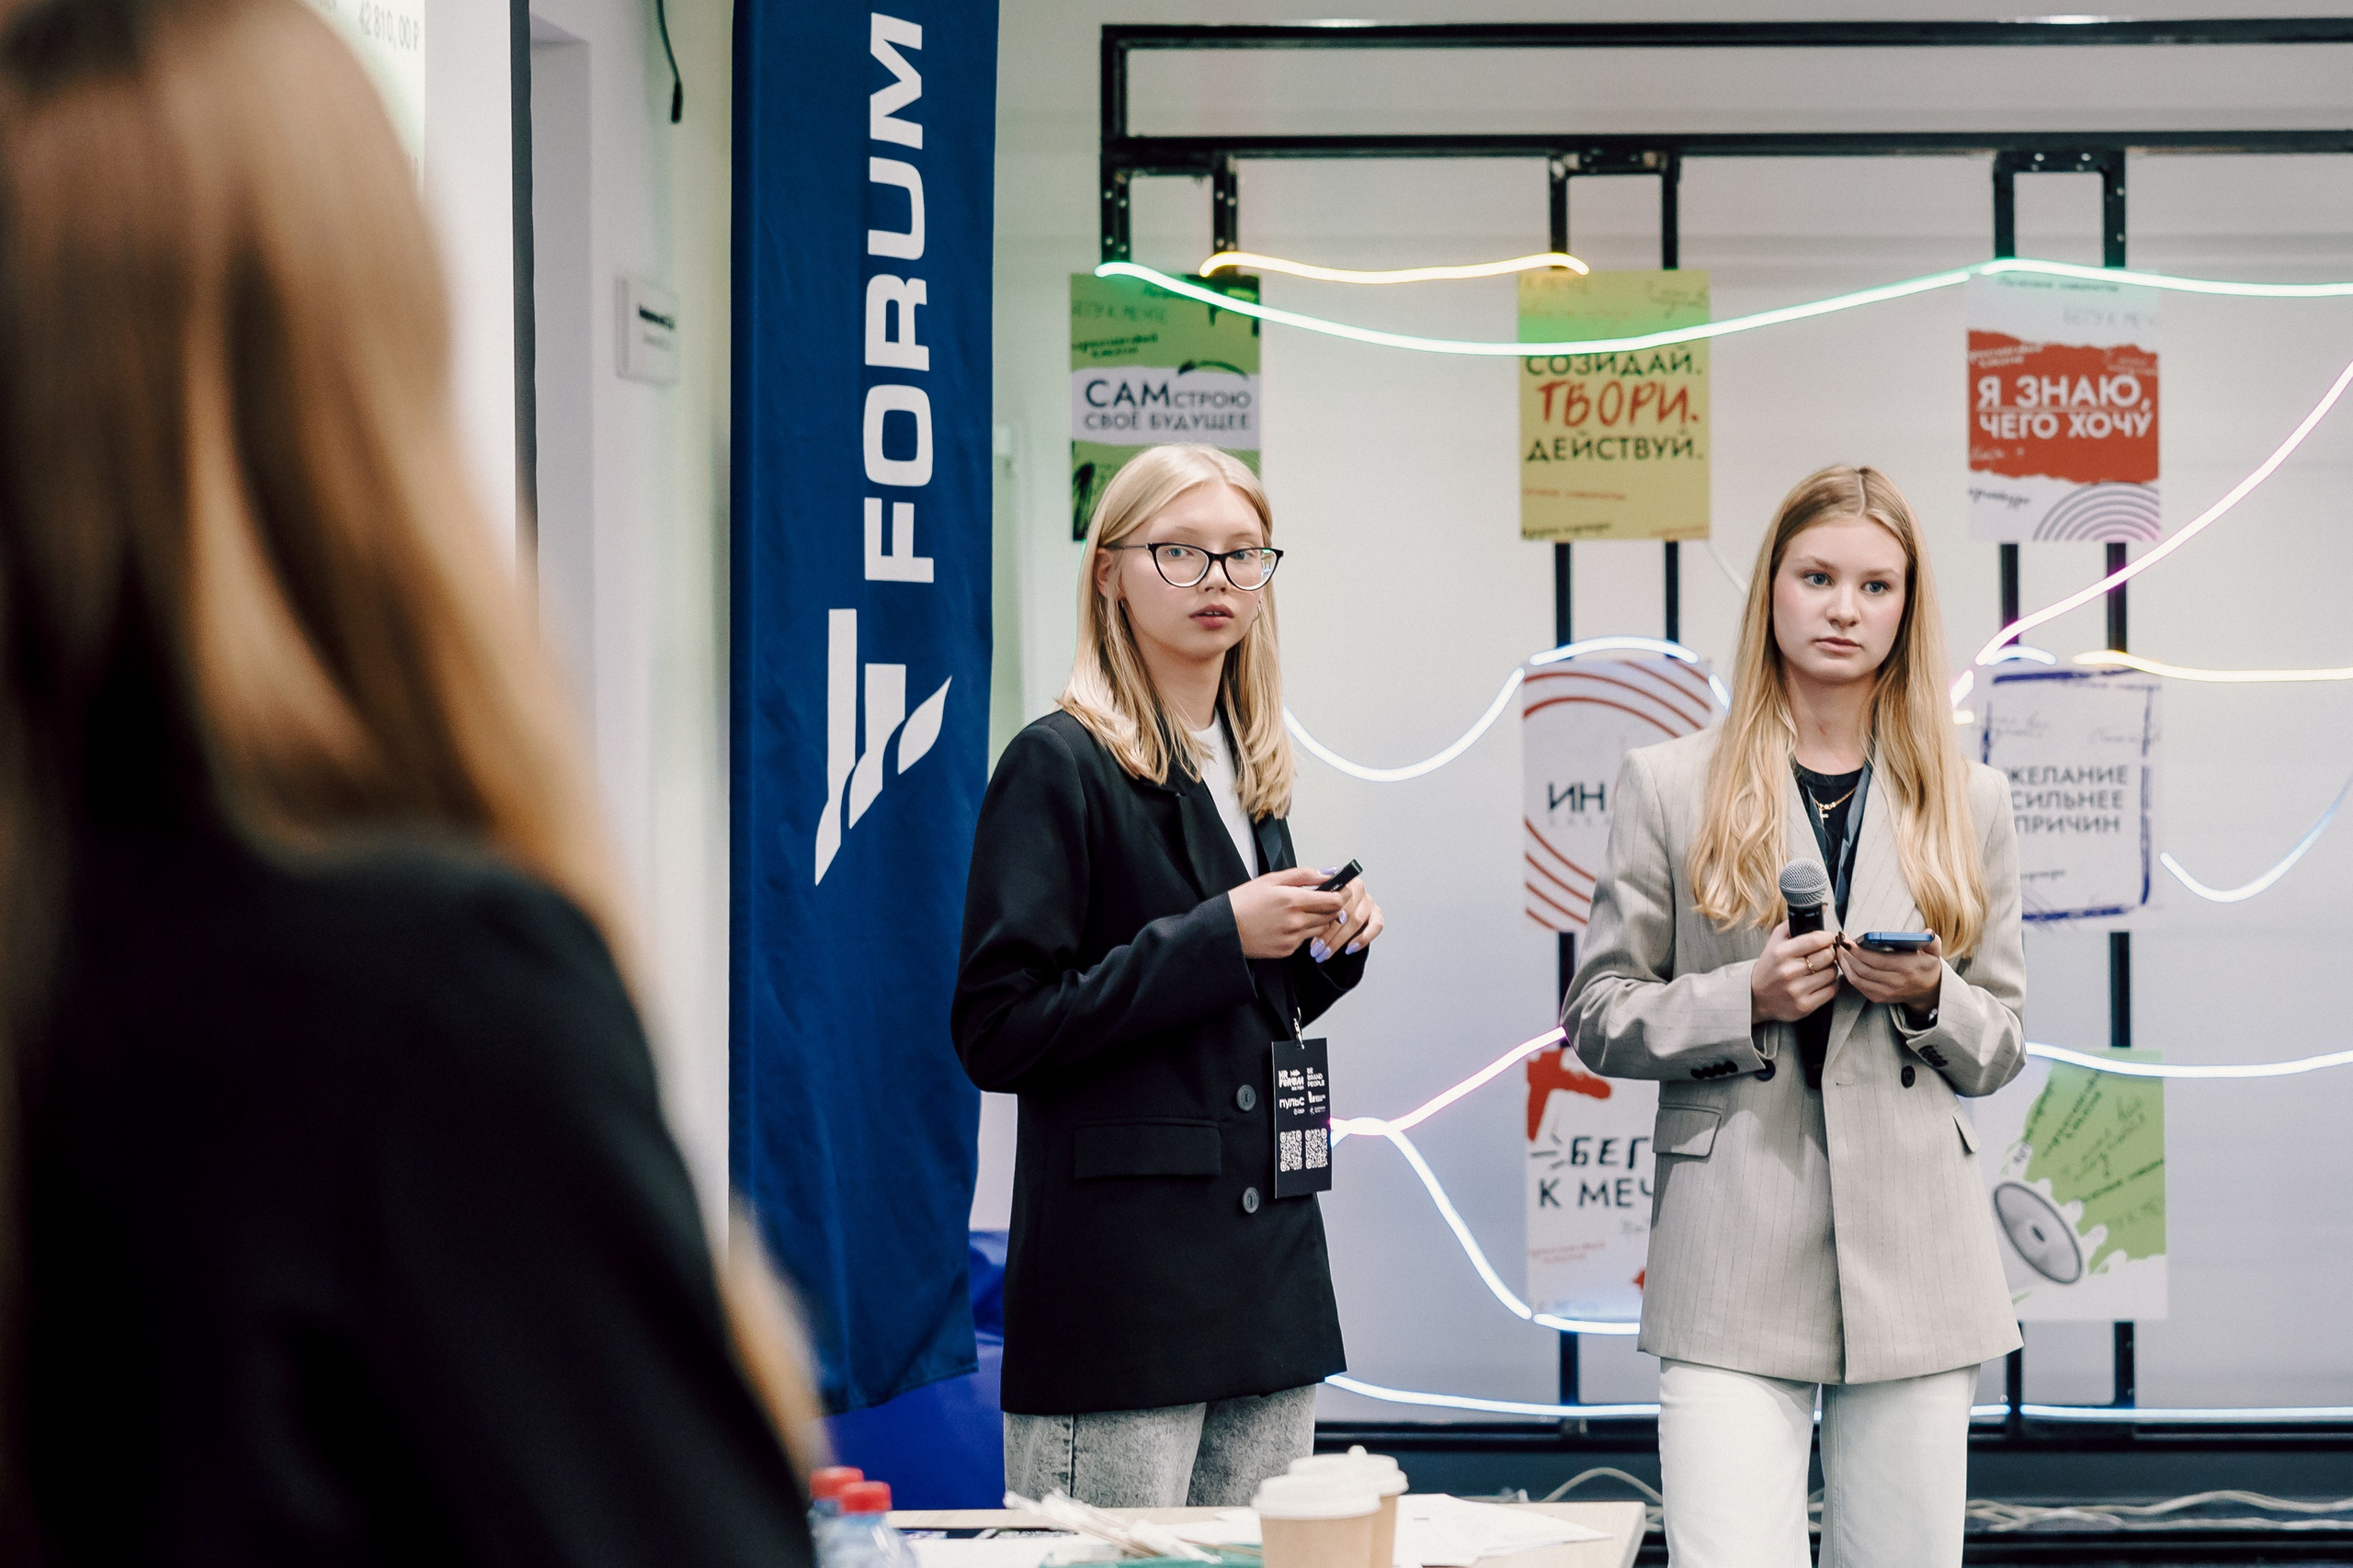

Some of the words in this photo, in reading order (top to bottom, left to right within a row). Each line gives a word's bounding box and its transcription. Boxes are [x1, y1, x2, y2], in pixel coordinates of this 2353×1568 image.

[863, 12, 934, 584] FORUM
[1525, 344, 1702, 376] СОЗИДАЙ.
[1538, 380, 1699, 427] ТВОРИ.
[1978, 374, 2001, 409] Я
[2015, 373, 2152, 411] ЗНАЮ,
[1979, 414, 2060, 439] ЧЕГО
[2067, 413, 2153, 438] ХОЧУ
[1525, 429, 1704, 461] ДЕЙСТВУЙ.
[2005, 765, 2127, 786] ЖЕЛАНИЕ
[2010, 790, 2122, 810] СИЛЬНЕЕ
[2014, 814, 2120, 833] ПРИЧИН
[1540, 1177, 1561, 1208] К
